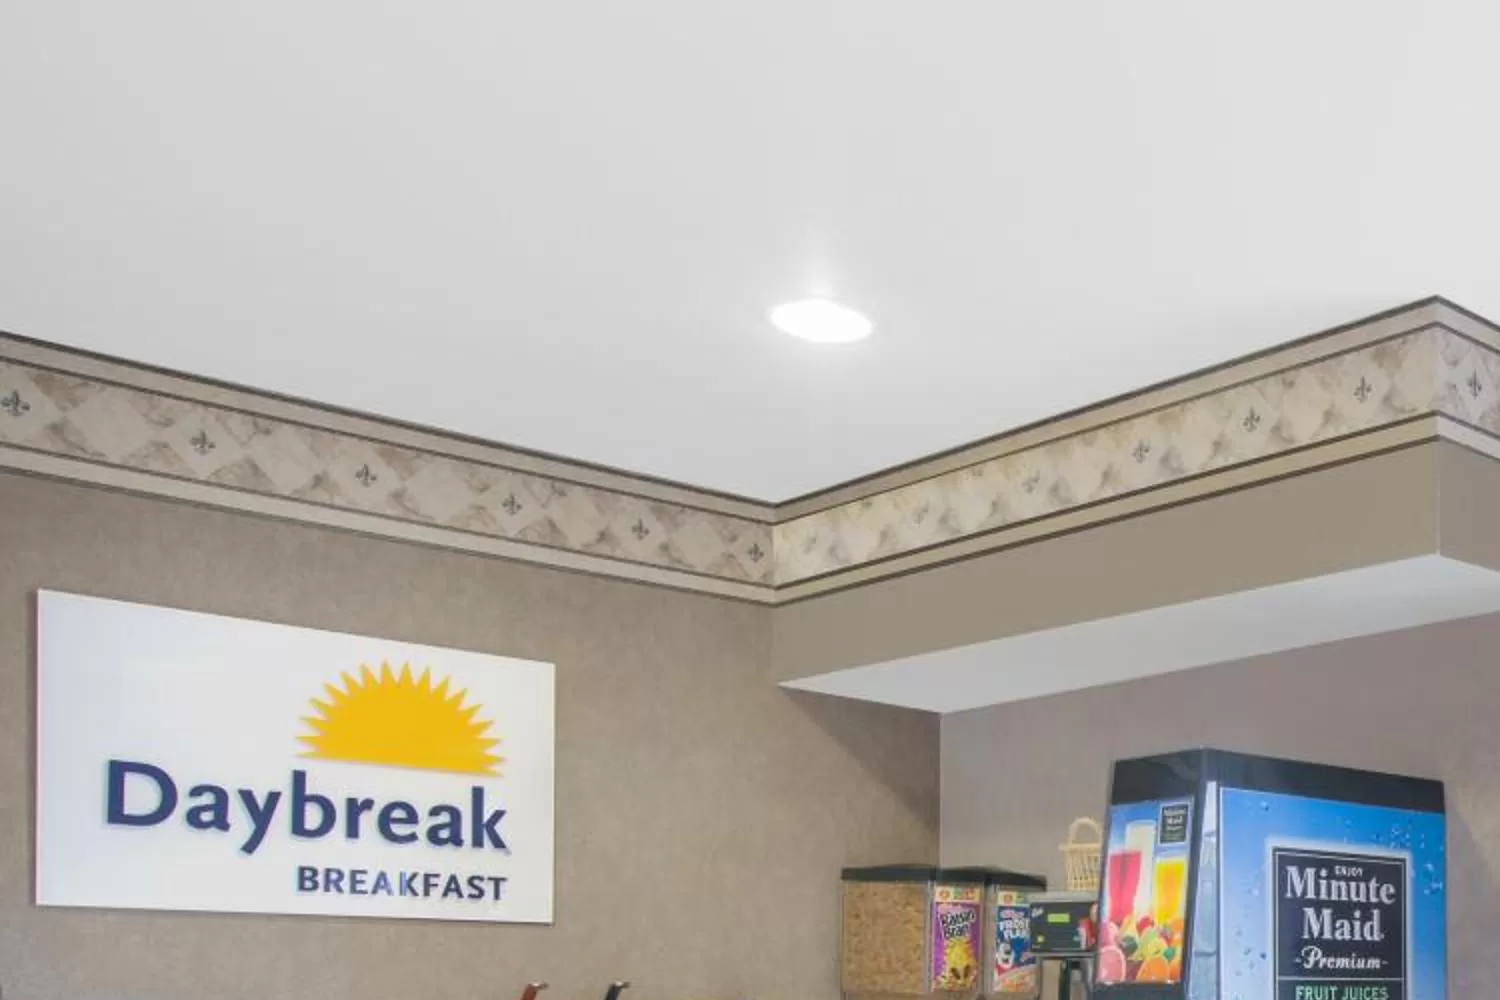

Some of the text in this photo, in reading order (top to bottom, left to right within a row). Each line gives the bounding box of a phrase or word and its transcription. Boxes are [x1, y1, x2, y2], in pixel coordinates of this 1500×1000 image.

[107, 759, 507, 854] Daybreak
[297, 865, 508, 901] BREAKFAST
[1284, 865, 1397, 904] Minute
[1334, 865, 1363, 877] ENJOY
[1301, 907, 1381, 941] Maid
[1295, 984, 1389, 1000] FRUIT JUICES
